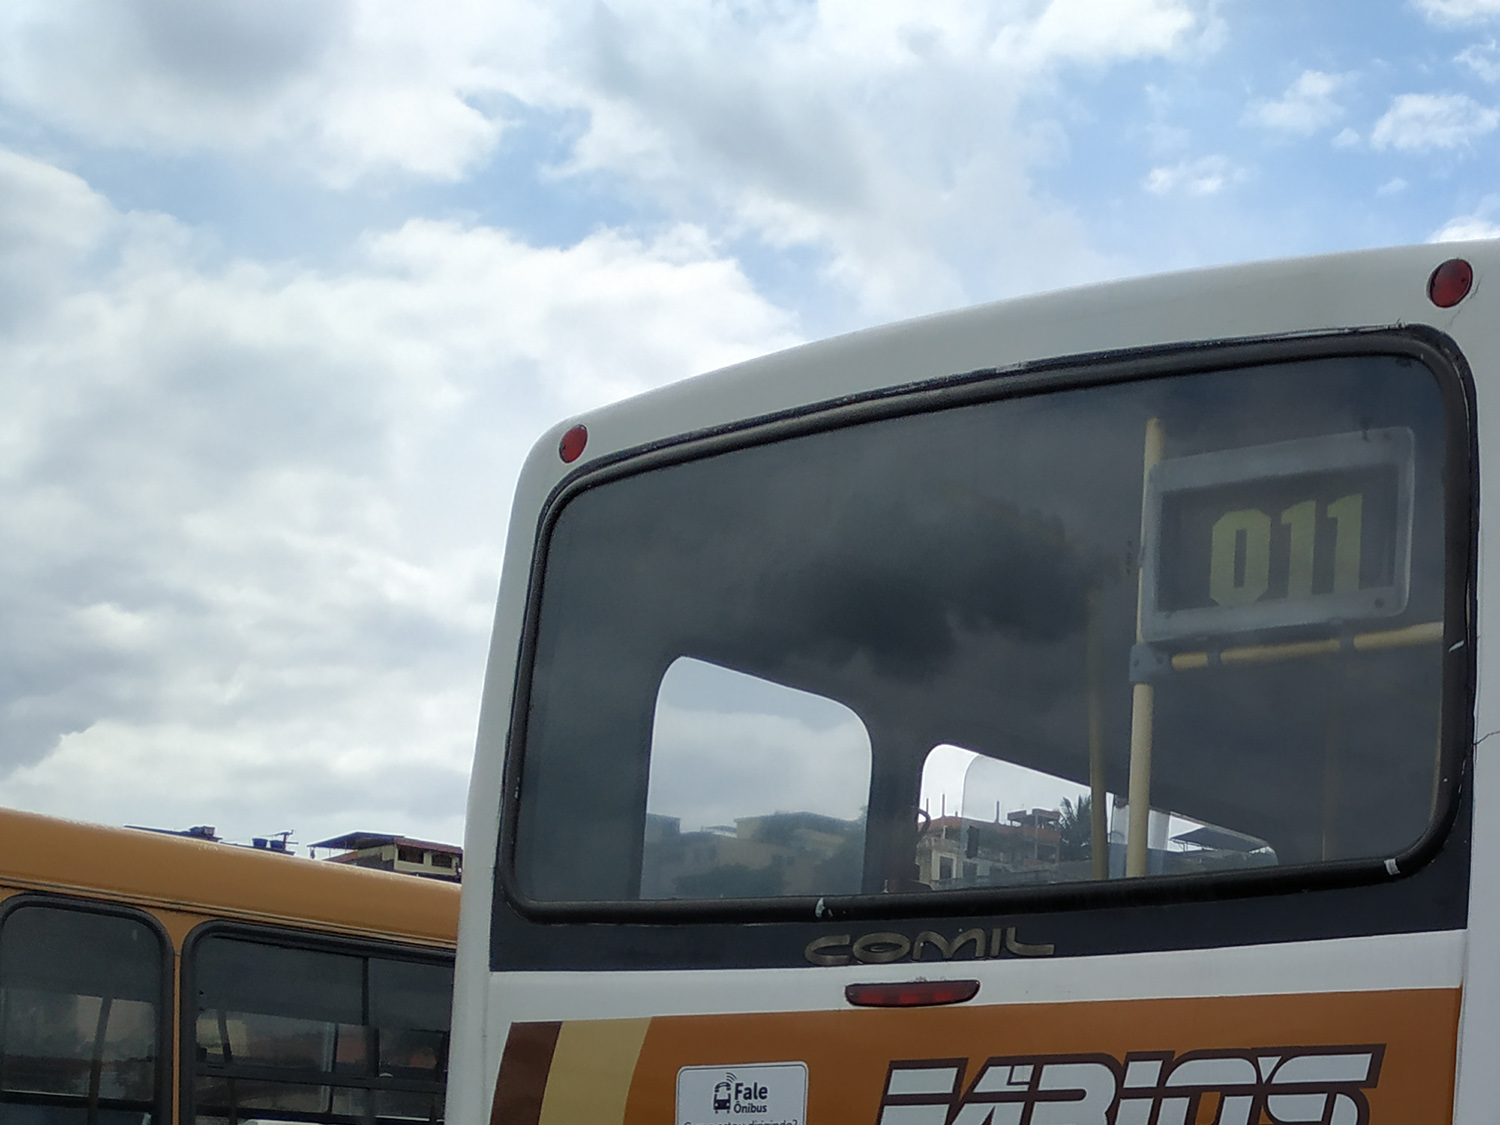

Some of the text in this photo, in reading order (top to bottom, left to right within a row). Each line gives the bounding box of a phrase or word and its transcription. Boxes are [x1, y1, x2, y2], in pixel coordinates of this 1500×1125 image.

[1209, 493, 1363, 607] 011
[804, 926, 1055, 966] COMIL
[734, 1082, 768, 1100] Fale
[733, 1101, 768, 1114] Ônibus
